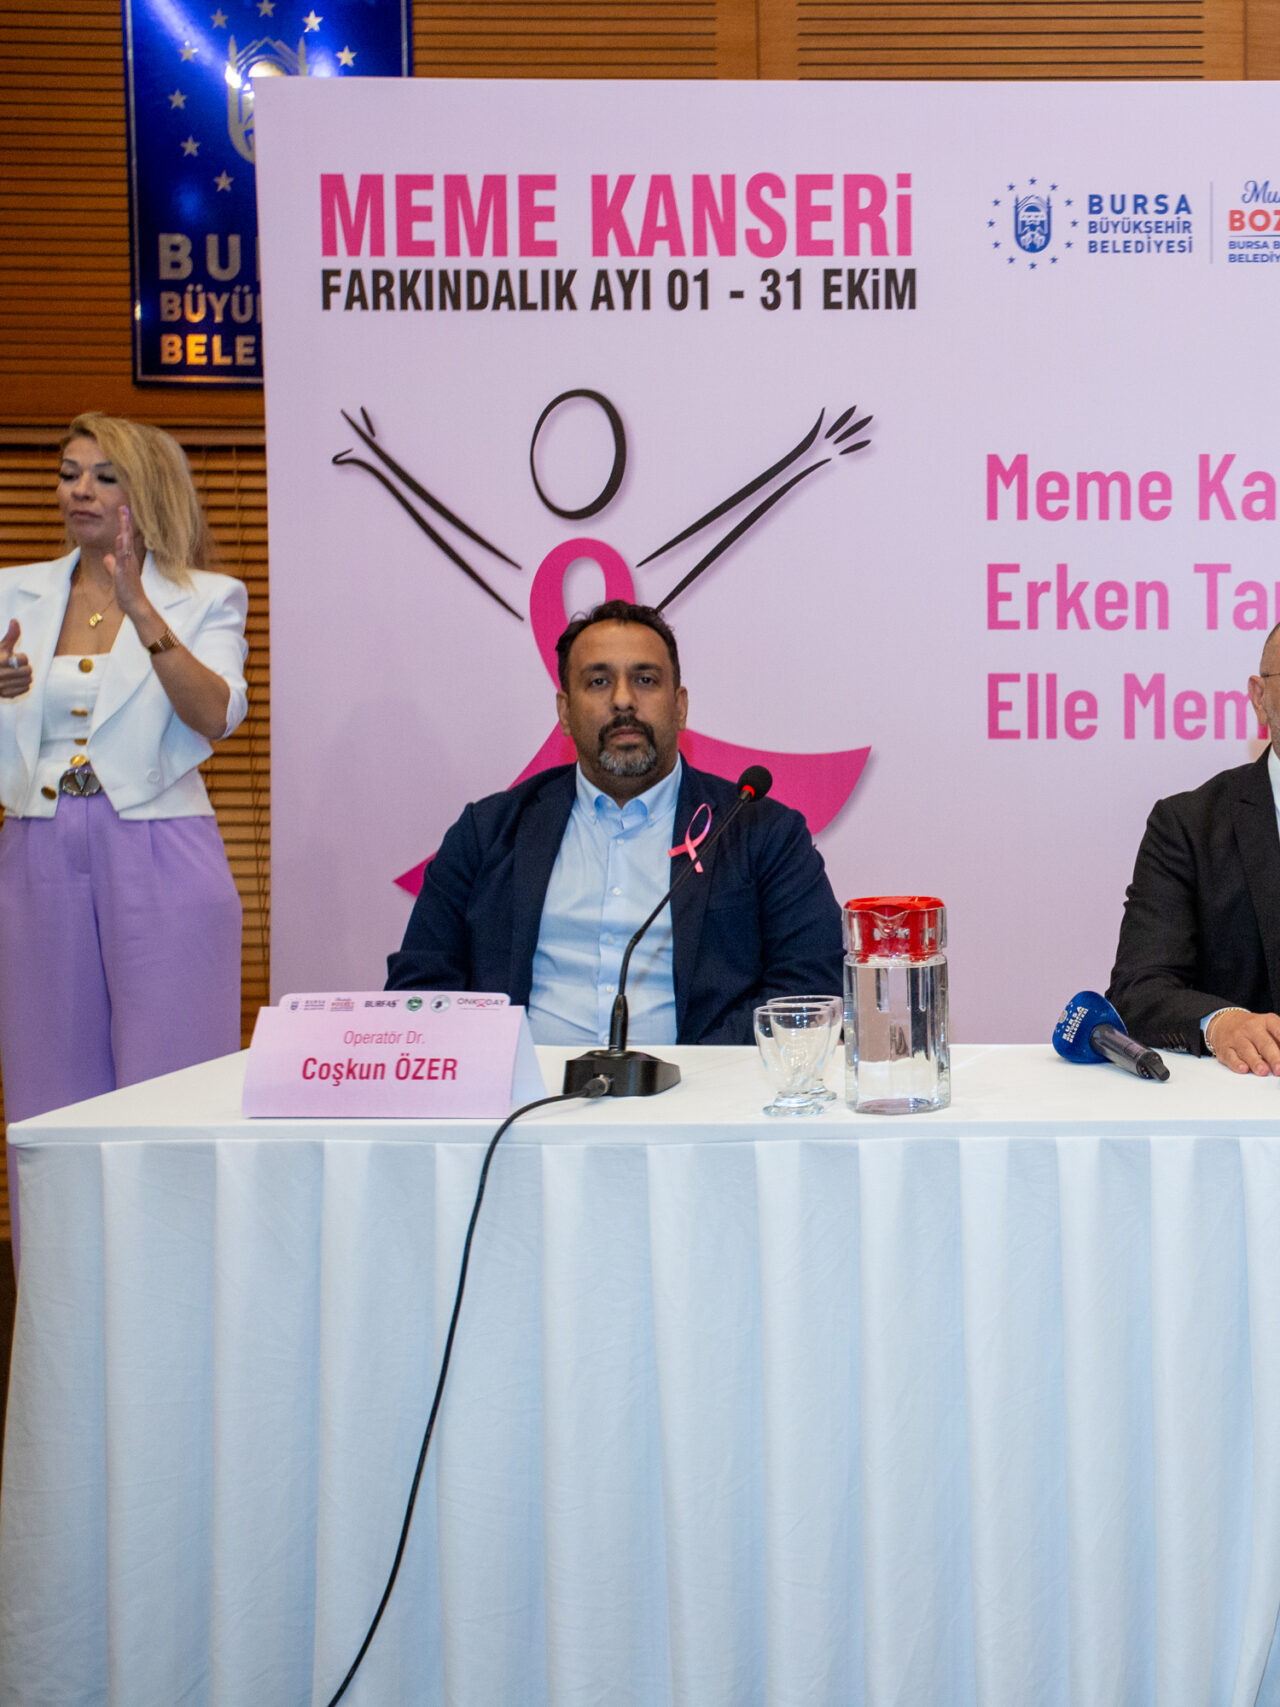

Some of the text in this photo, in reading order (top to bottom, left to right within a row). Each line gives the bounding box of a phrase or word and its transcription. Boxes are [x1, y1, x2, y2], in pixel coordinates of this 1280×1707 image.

[320, 174, 558, 258] MEME
[1088, 193, 1192, 215] BURSA
[158, 233, 261, 281] BU
[1088, 236, 1193, 254] BELEDİYESİ
[1228, 240, 1270, 250] BURSA
[160, 283, 263, 323] BÜYÜ
[321, 269, 578, 311] FARKINDALIK
[590, 269, 651, 311] AYI
[667, 269, 710, 311] 01
[760, 269, 802, 311] 31
[987, 453, 1173, 522] Meme
[987, 563, 1170, 631] Erken
[987, 672, 1099, 741] Elle
[1123, 673, 1269, 741] Mem
[343, 1030, 426, 1047] Operatör Dr.
[302, 1052, 459, 1087] Coşkun ÖZER
